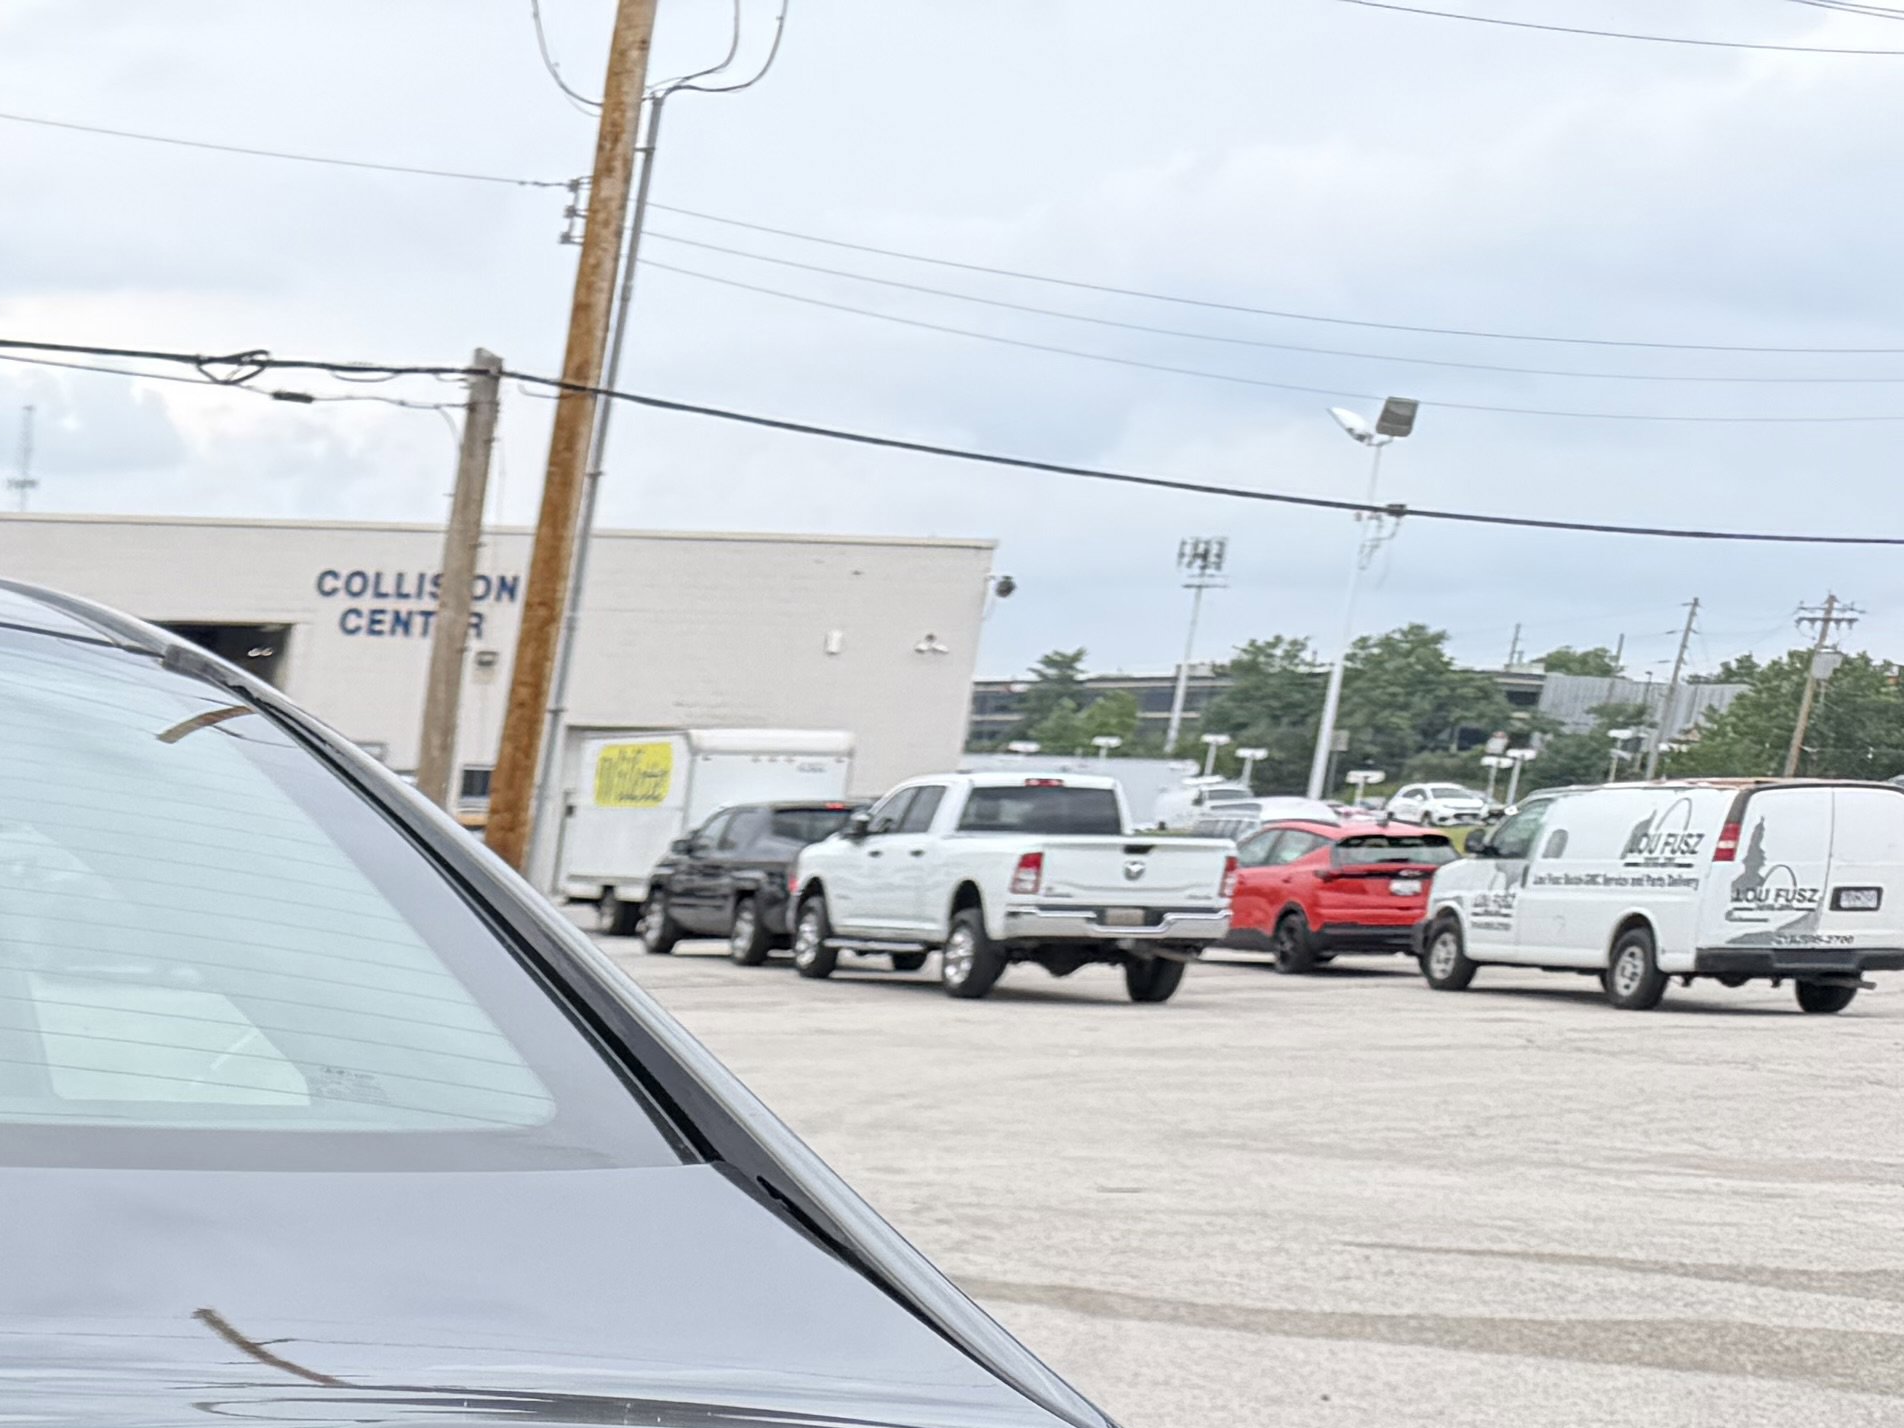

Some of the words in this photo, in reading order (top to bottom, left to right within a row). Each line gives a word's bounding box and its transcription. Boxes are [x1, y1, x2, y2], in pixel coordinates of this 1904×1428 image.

[317, 570, 520, 602] COLLISON
[339, 607, 485, 638] CENTR
[1626, 832, 1662, 855] LOU
[1660, 832, 1705, 855] FUSZ
[1732, 888, 1770, 903] LOU
[1774, 888, 1820, 903] FUSZ
